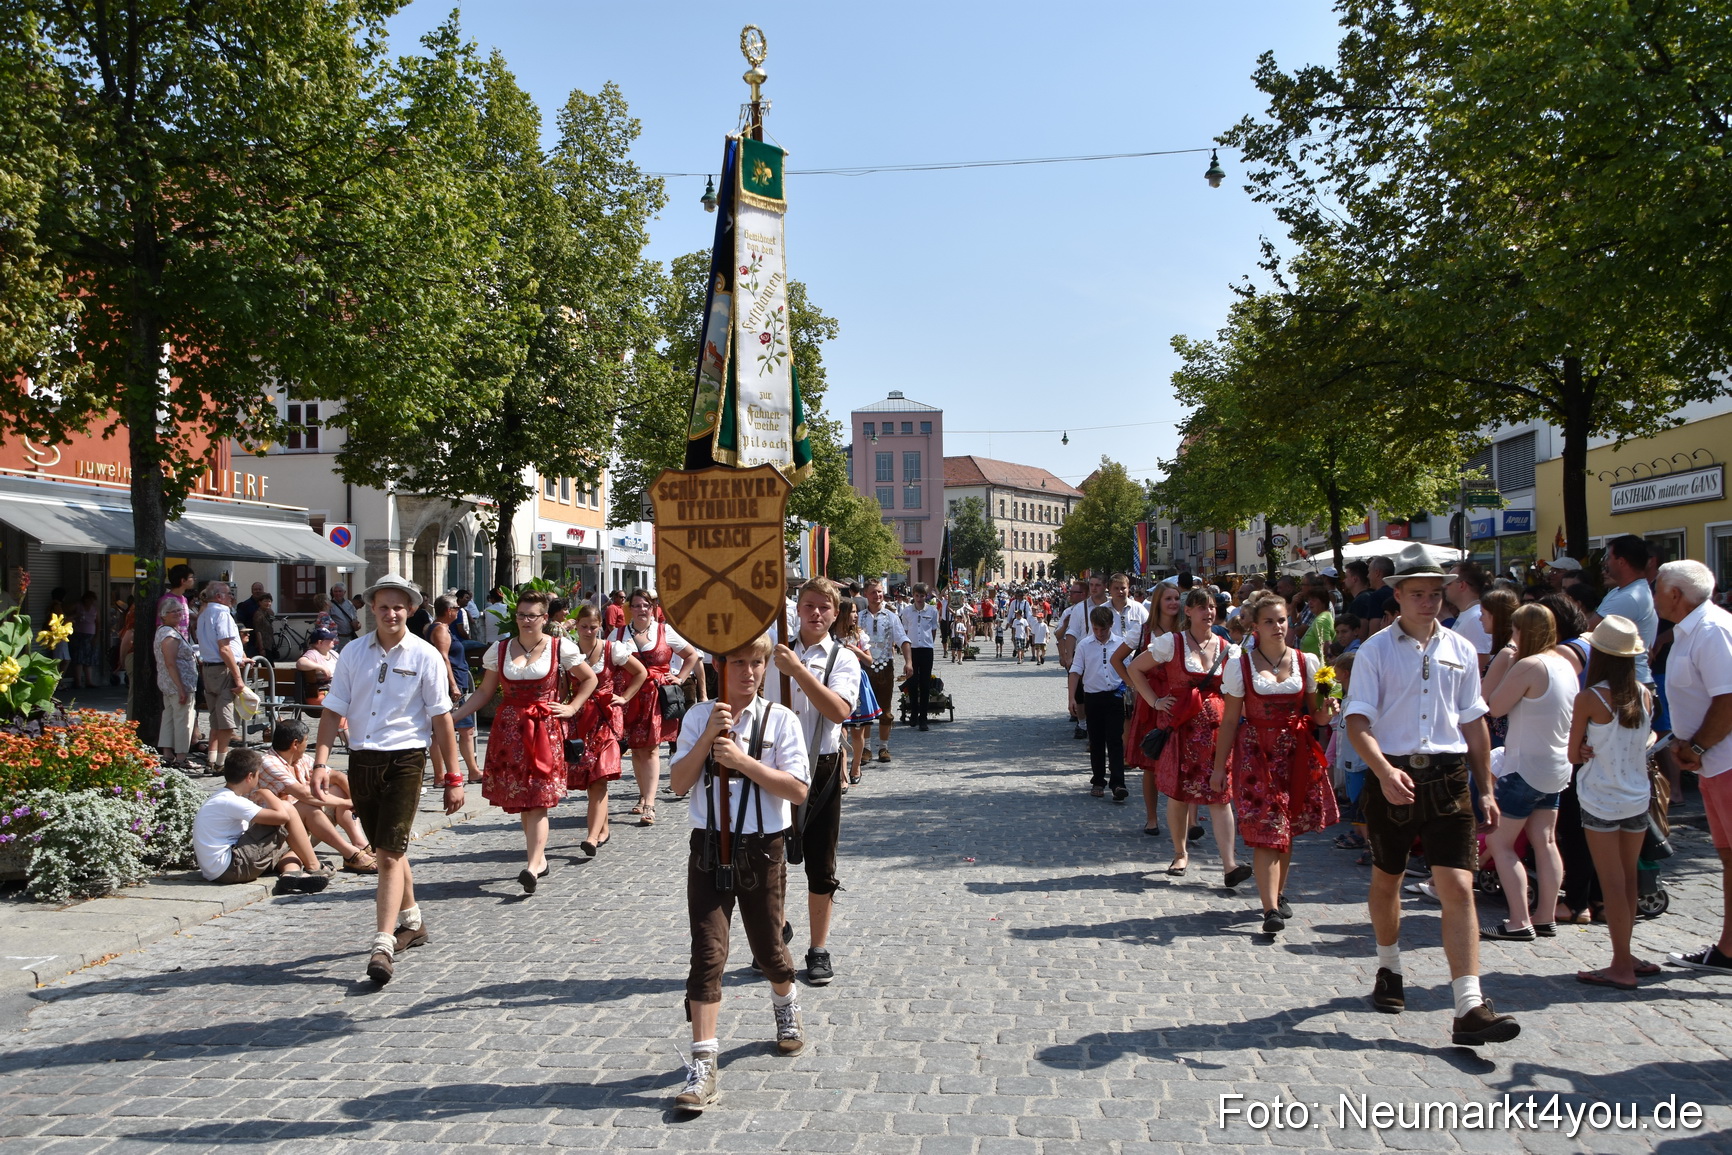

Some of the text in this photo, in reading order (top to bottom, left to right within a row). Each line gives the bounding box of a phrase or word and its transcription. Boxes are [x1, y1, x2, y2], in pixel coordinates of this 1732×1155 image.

[754, 420, 780, 432] weihe
[742, 435, 788, 452] Pilsach
[658, 475, 781, 501] SCHÜTZENVER.
[1613, 473, 1718, 507] GASTHAUS mittlere GANS
[677, 499, 758, 520] OTTOBURG
[1506, 515, 1529, 524] APOLLO
[687, 528, 751, 549] PILSACH
[661, 559, 778, 591] 19 65
